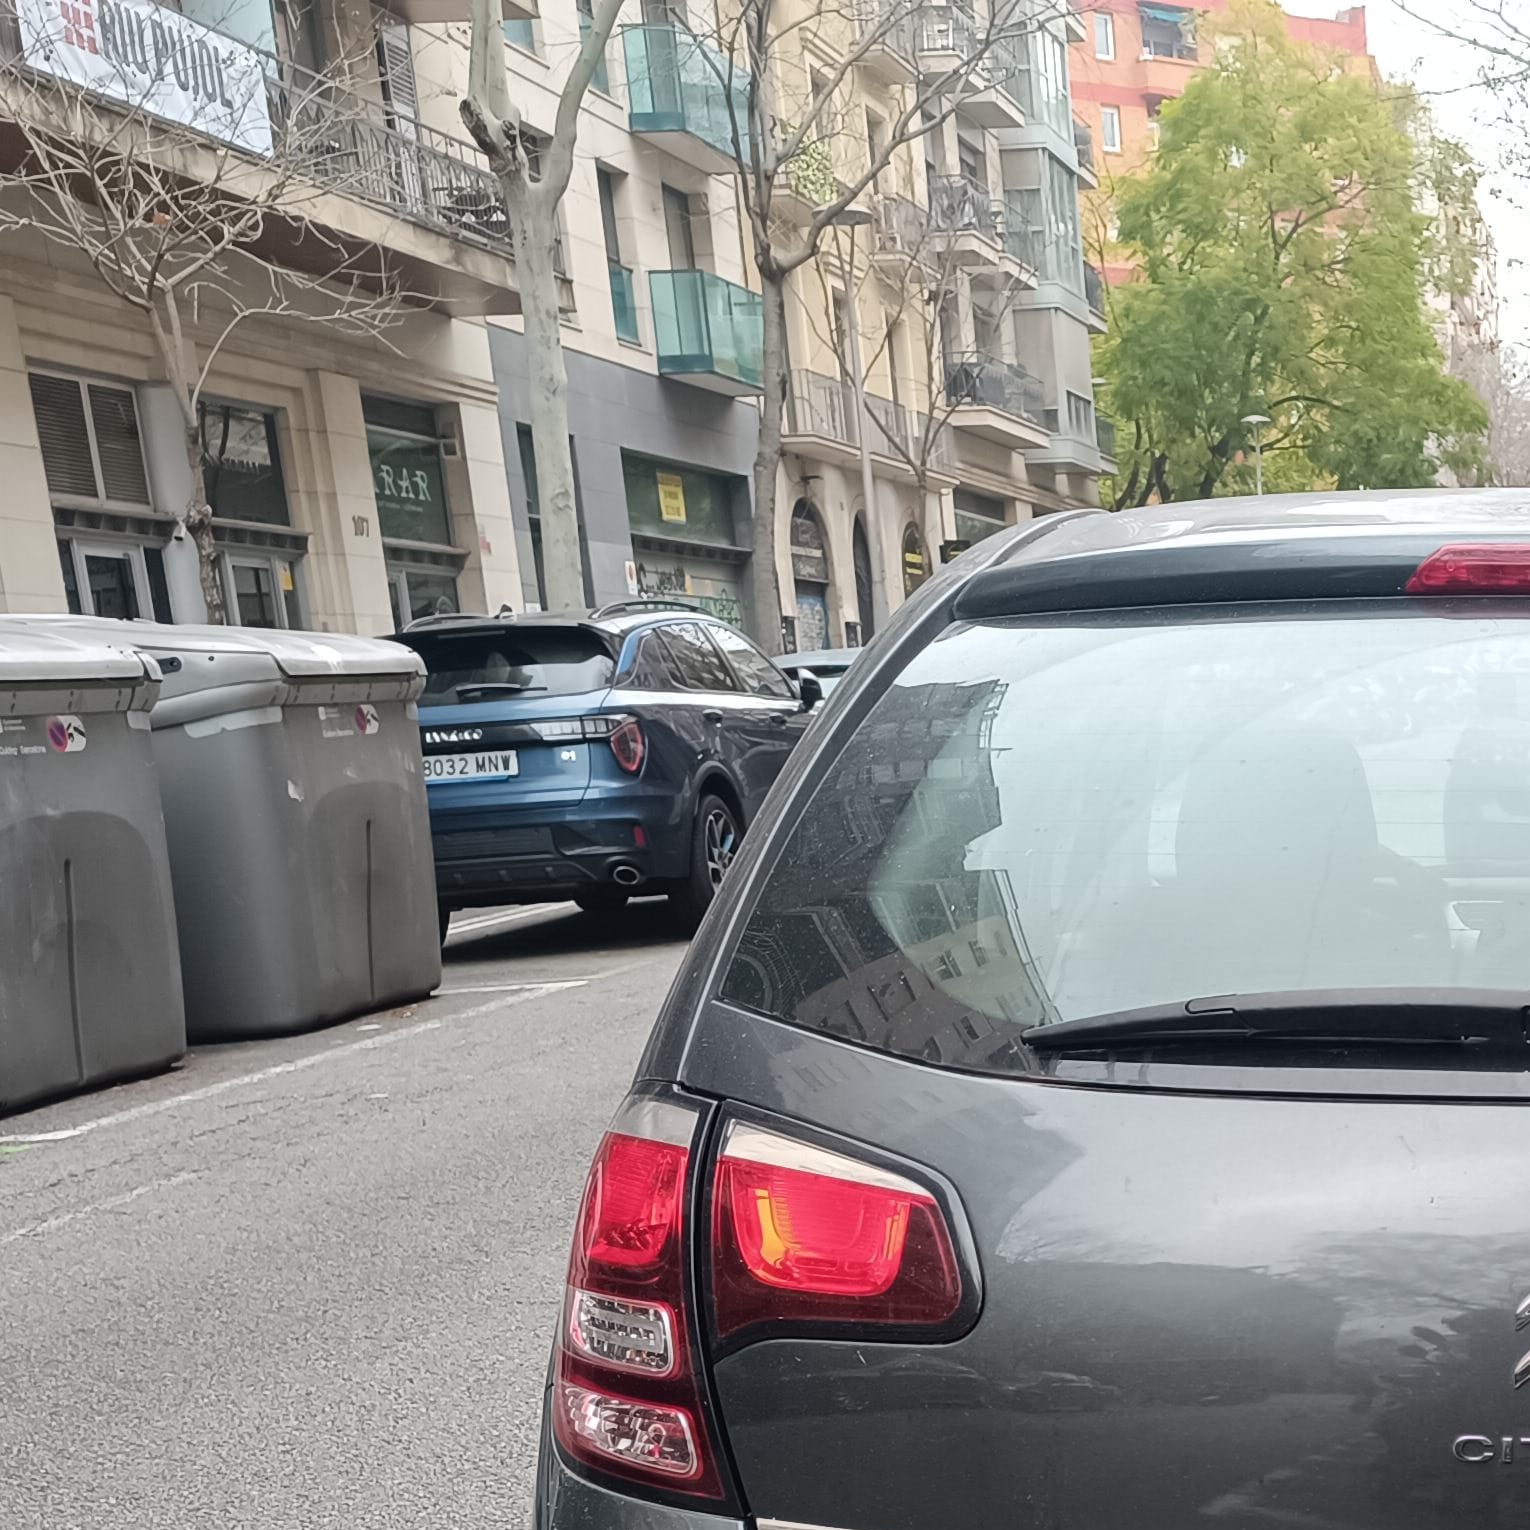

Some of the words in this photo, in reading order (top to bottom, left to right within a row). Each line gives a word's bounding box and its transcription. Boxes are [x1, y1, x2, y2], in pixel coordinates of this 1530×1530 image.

[151, 18, 234, 109] PUJOL
[375, 464, 432, 502] RAR
[422, 757, 469, 777] 8032
[475, 754, 511, 774] MNW
